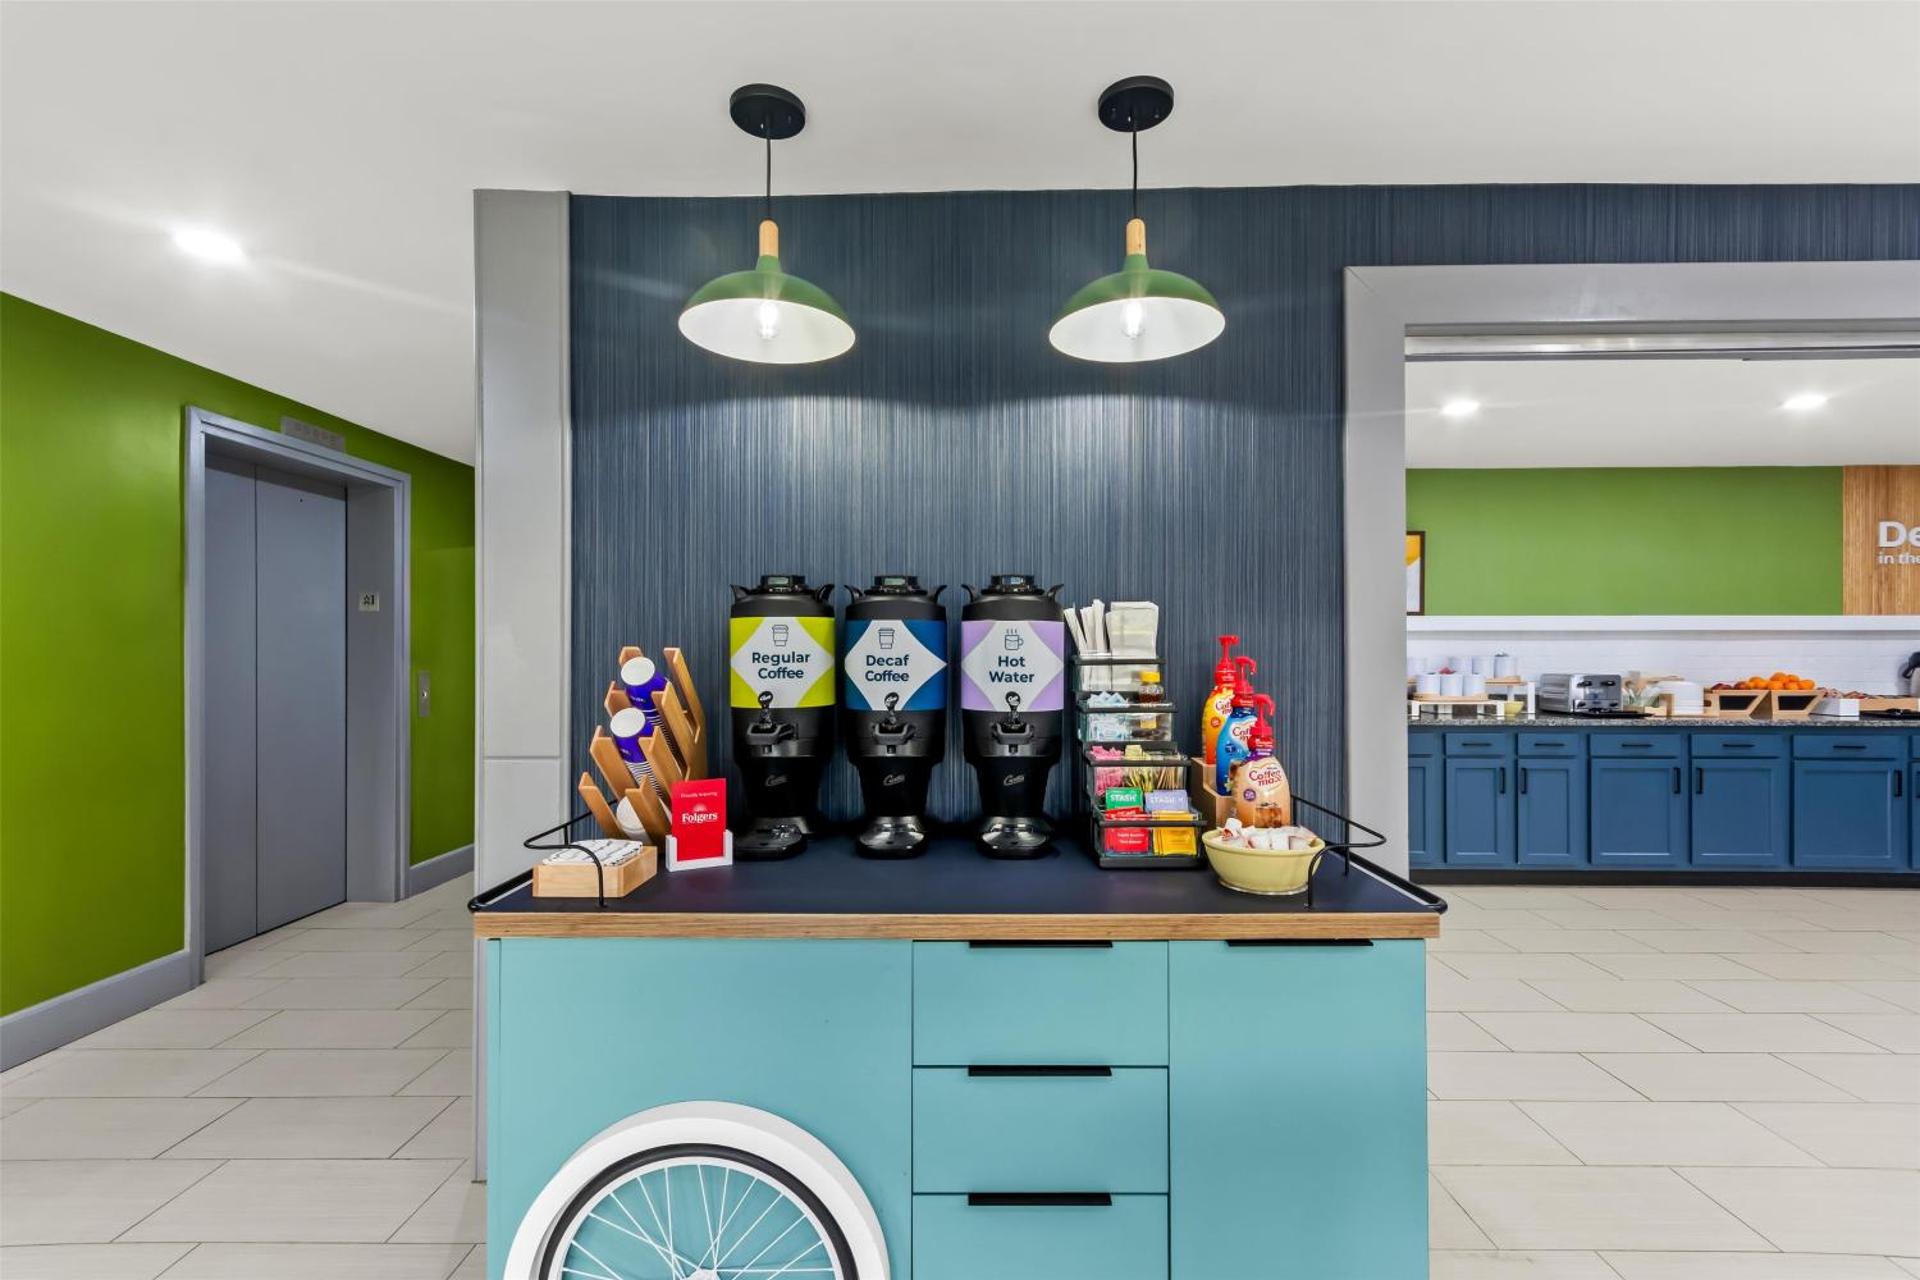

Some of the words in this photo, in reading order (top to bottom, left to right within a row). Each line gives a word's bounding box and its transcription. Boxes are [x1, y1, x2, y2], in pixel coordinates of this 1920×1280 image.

[1879, 552, 1894, 564] in
[752, 651, 811, 666] Regular
[866, 654, 909, 666] Decaf
[998, 655, 1025, 668] Hot
[758, 667, 804, 679] Coffee
[865, 669, 909, 682] Coffee
[989, 671, 1034, 683] Water
[1249, 770, 1281, 781] Coffee
[1110, 794, 1137, 802] STASH
[681, 812, 718, 824] Folgers
